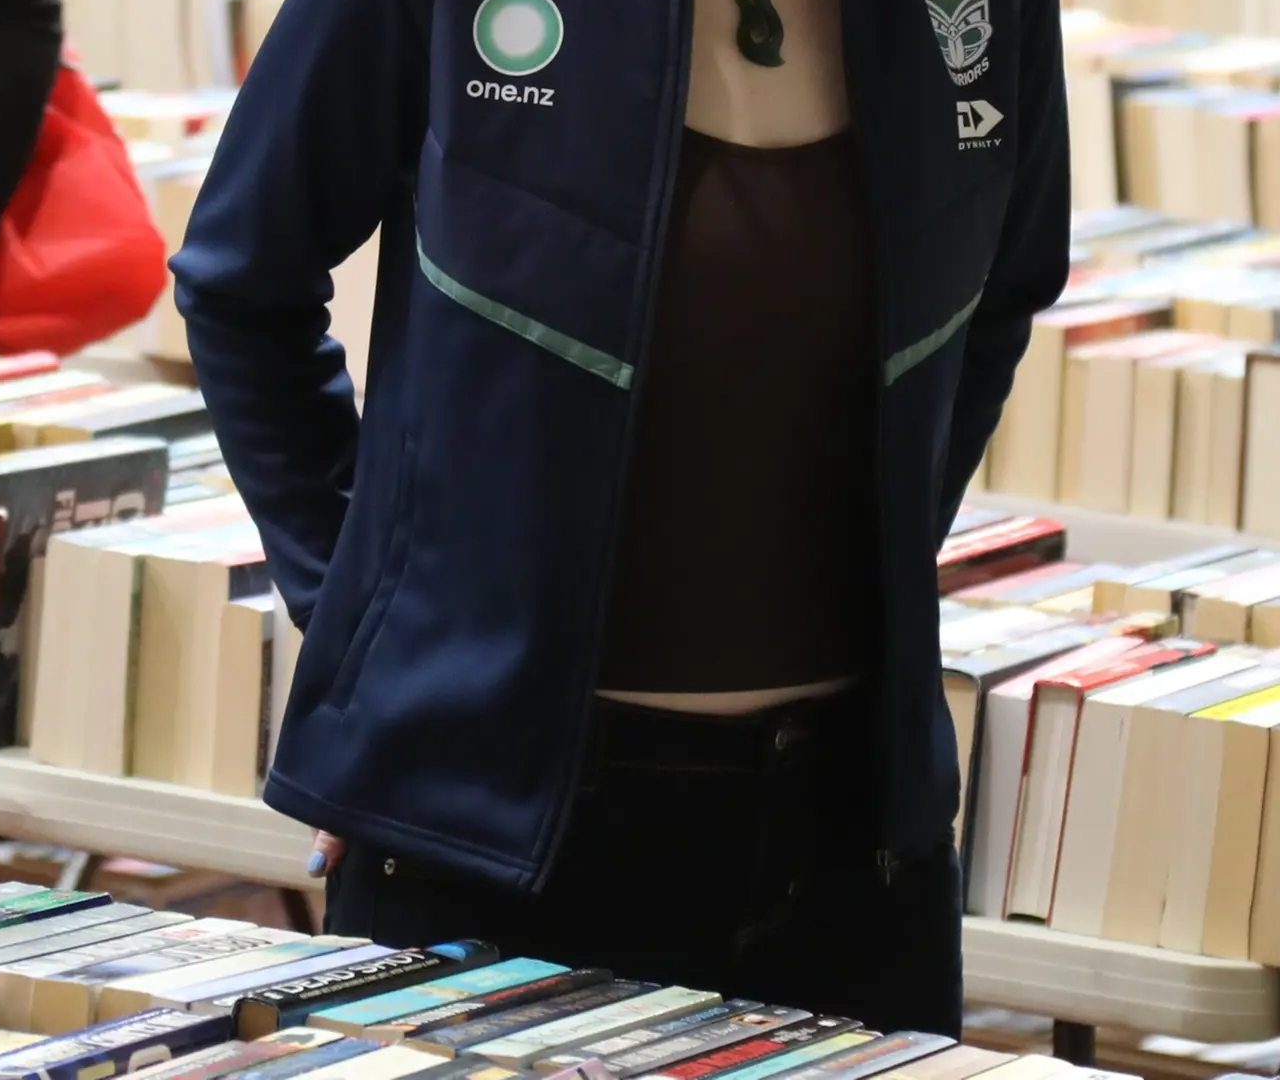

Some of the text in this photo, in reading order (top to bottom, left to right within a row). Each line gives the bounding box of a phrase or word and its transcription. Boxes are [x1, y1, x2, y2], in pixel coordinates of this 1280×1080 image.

[466, 79, 556, 107] one.nz
[279, 970, 356, 993] DEAD
[348, 951, 425, 974] SHOT
